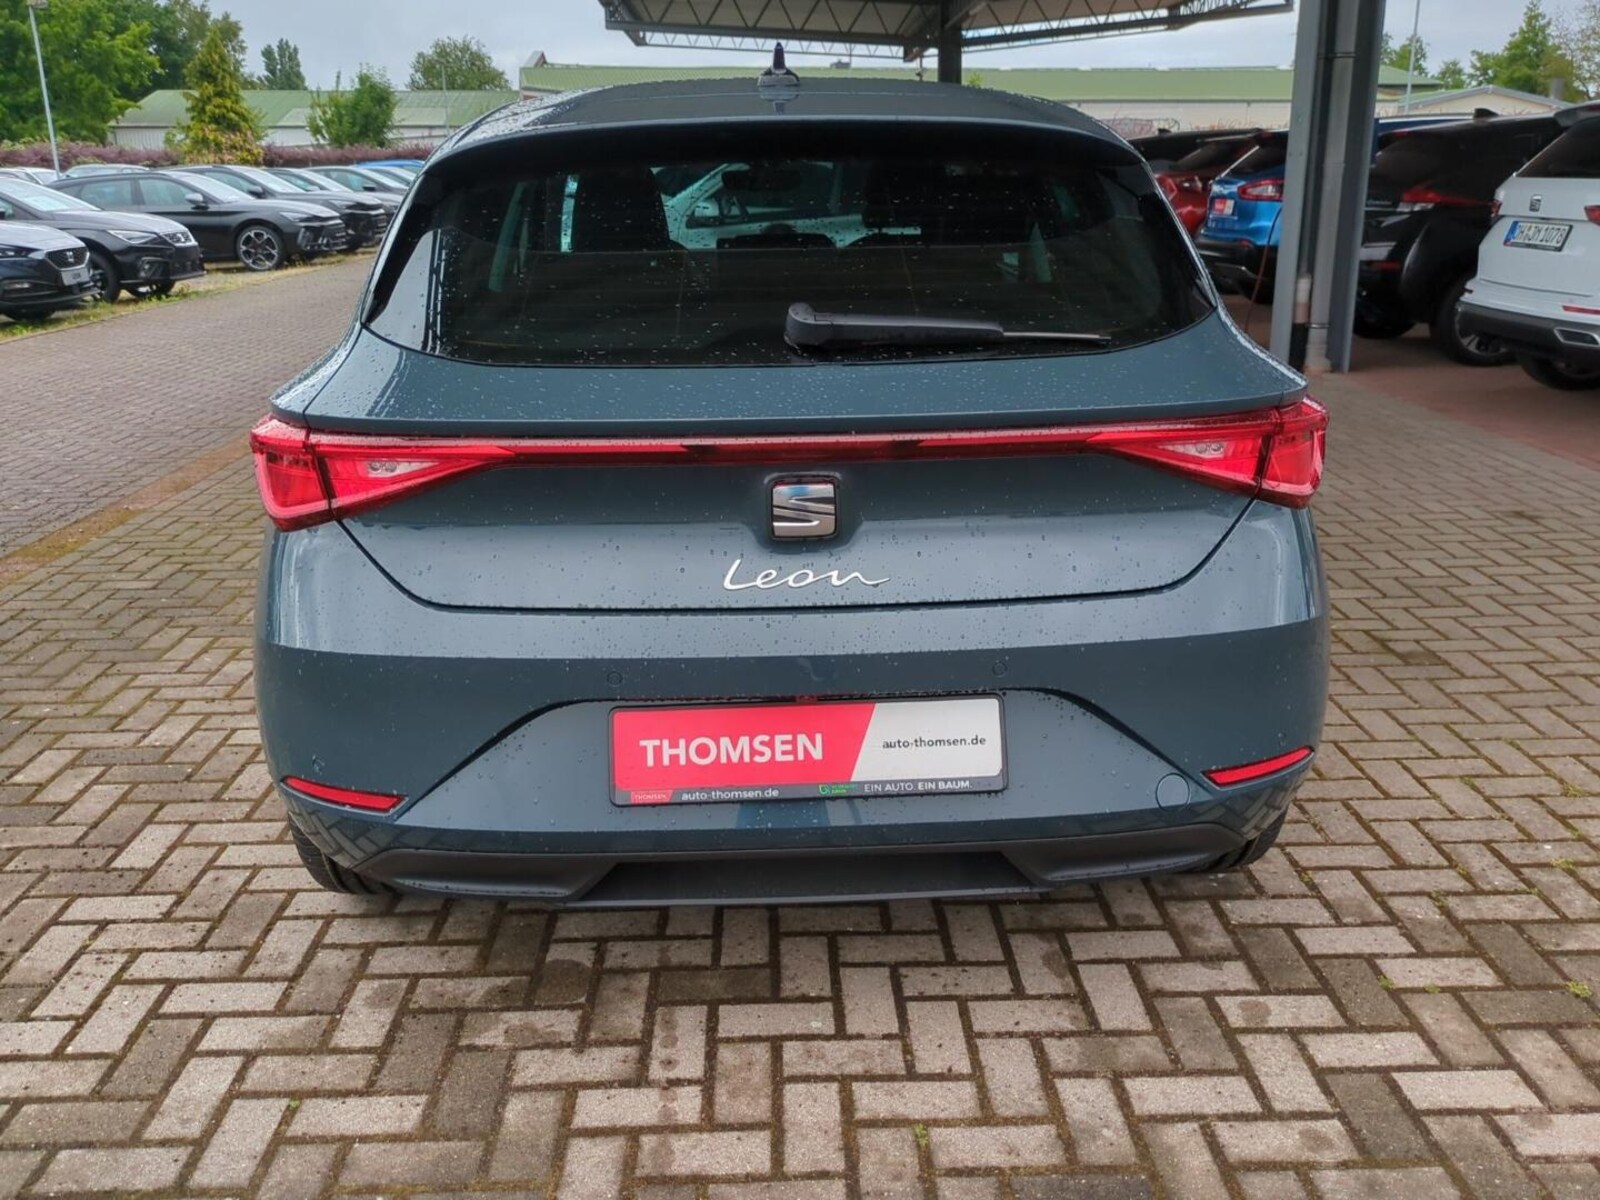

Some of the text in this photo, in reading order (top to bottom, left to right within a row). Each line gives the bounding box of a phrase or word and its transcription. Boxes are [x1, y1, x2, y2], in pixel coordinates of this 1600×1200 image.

[723, 559, 890, 591] Leon
[882, 734, 987, 749] auto-thomsen.de
[639, 732, 823, 768] THOMSEN
[681, 787, 780, 801] auto-thomsen.de
[864, 783, 882, 793] EIN
[918, 781, 936, 791] EIN
